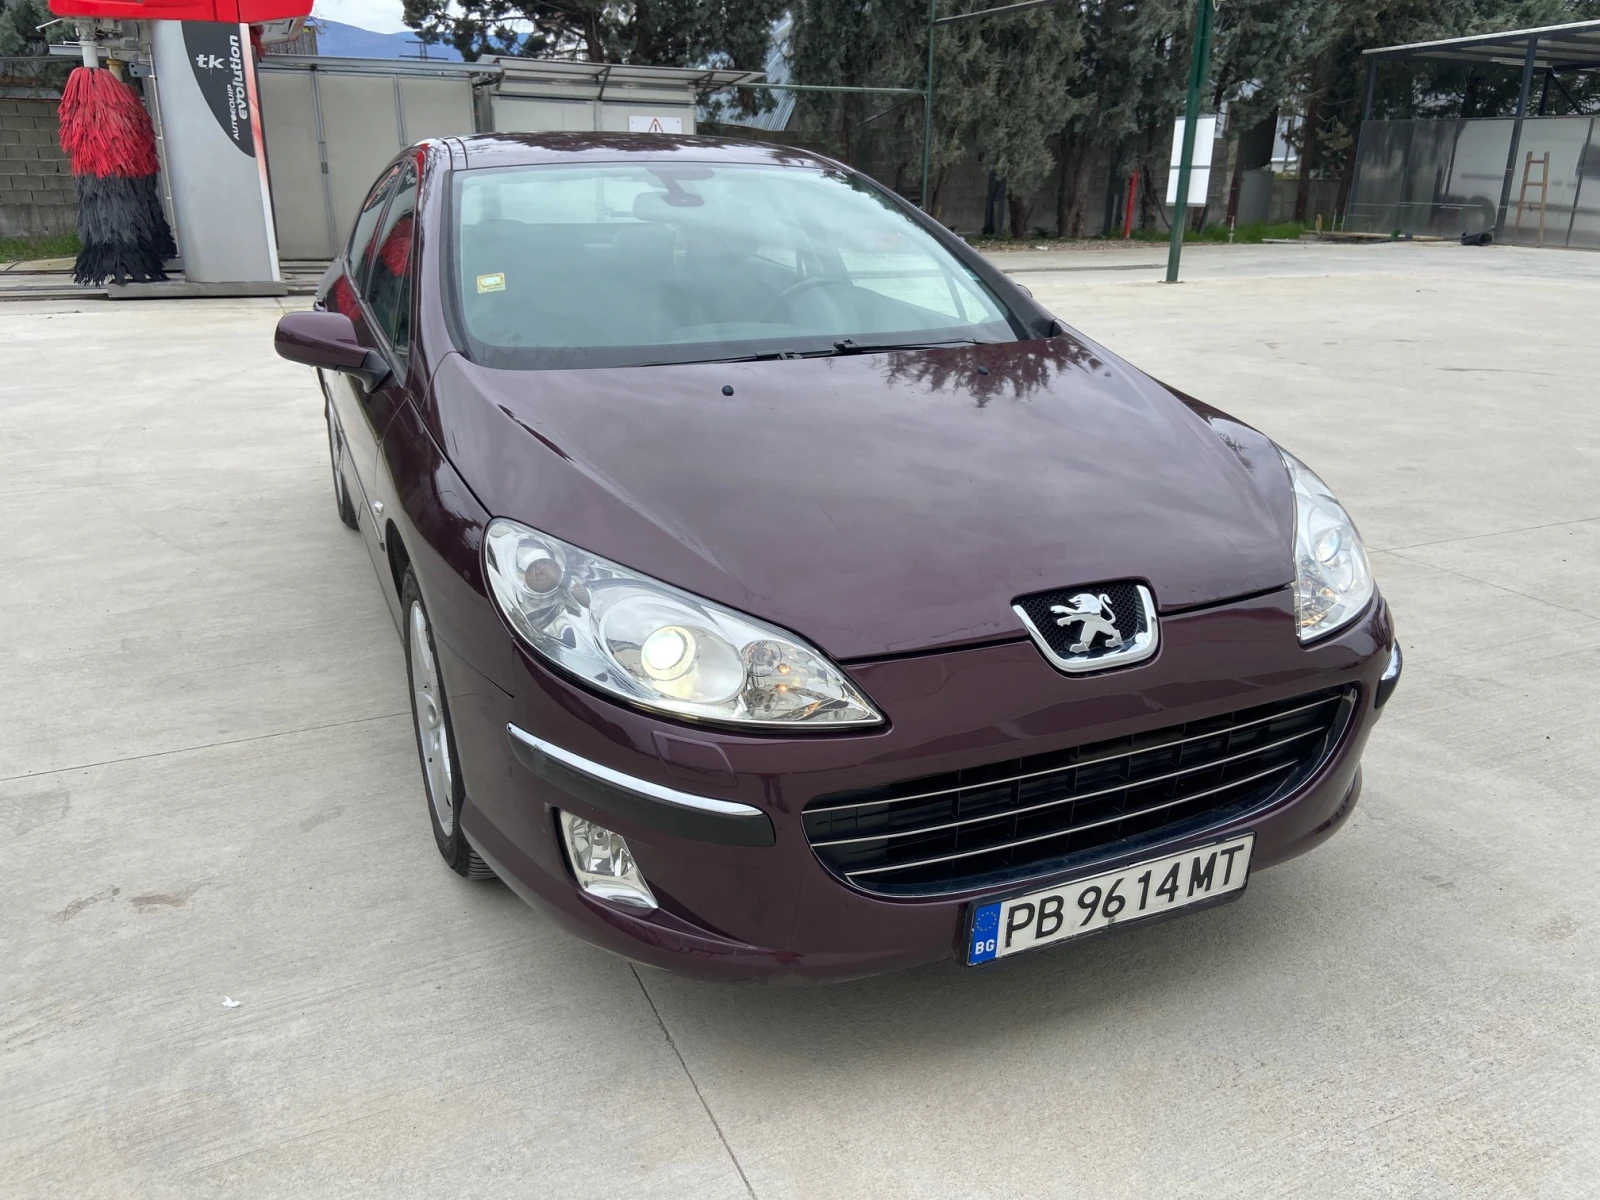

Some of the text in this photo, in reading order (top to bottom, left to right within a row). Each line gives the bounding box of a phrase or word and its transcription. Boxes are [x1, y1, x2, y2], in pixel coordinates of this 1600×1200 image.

[196, 54, 225, 69] tk
[229, 35, 248, 120] evolution
[1004, 844, 1245, 948] PB 9614 MT
[974, 938, 996, 956] BG
